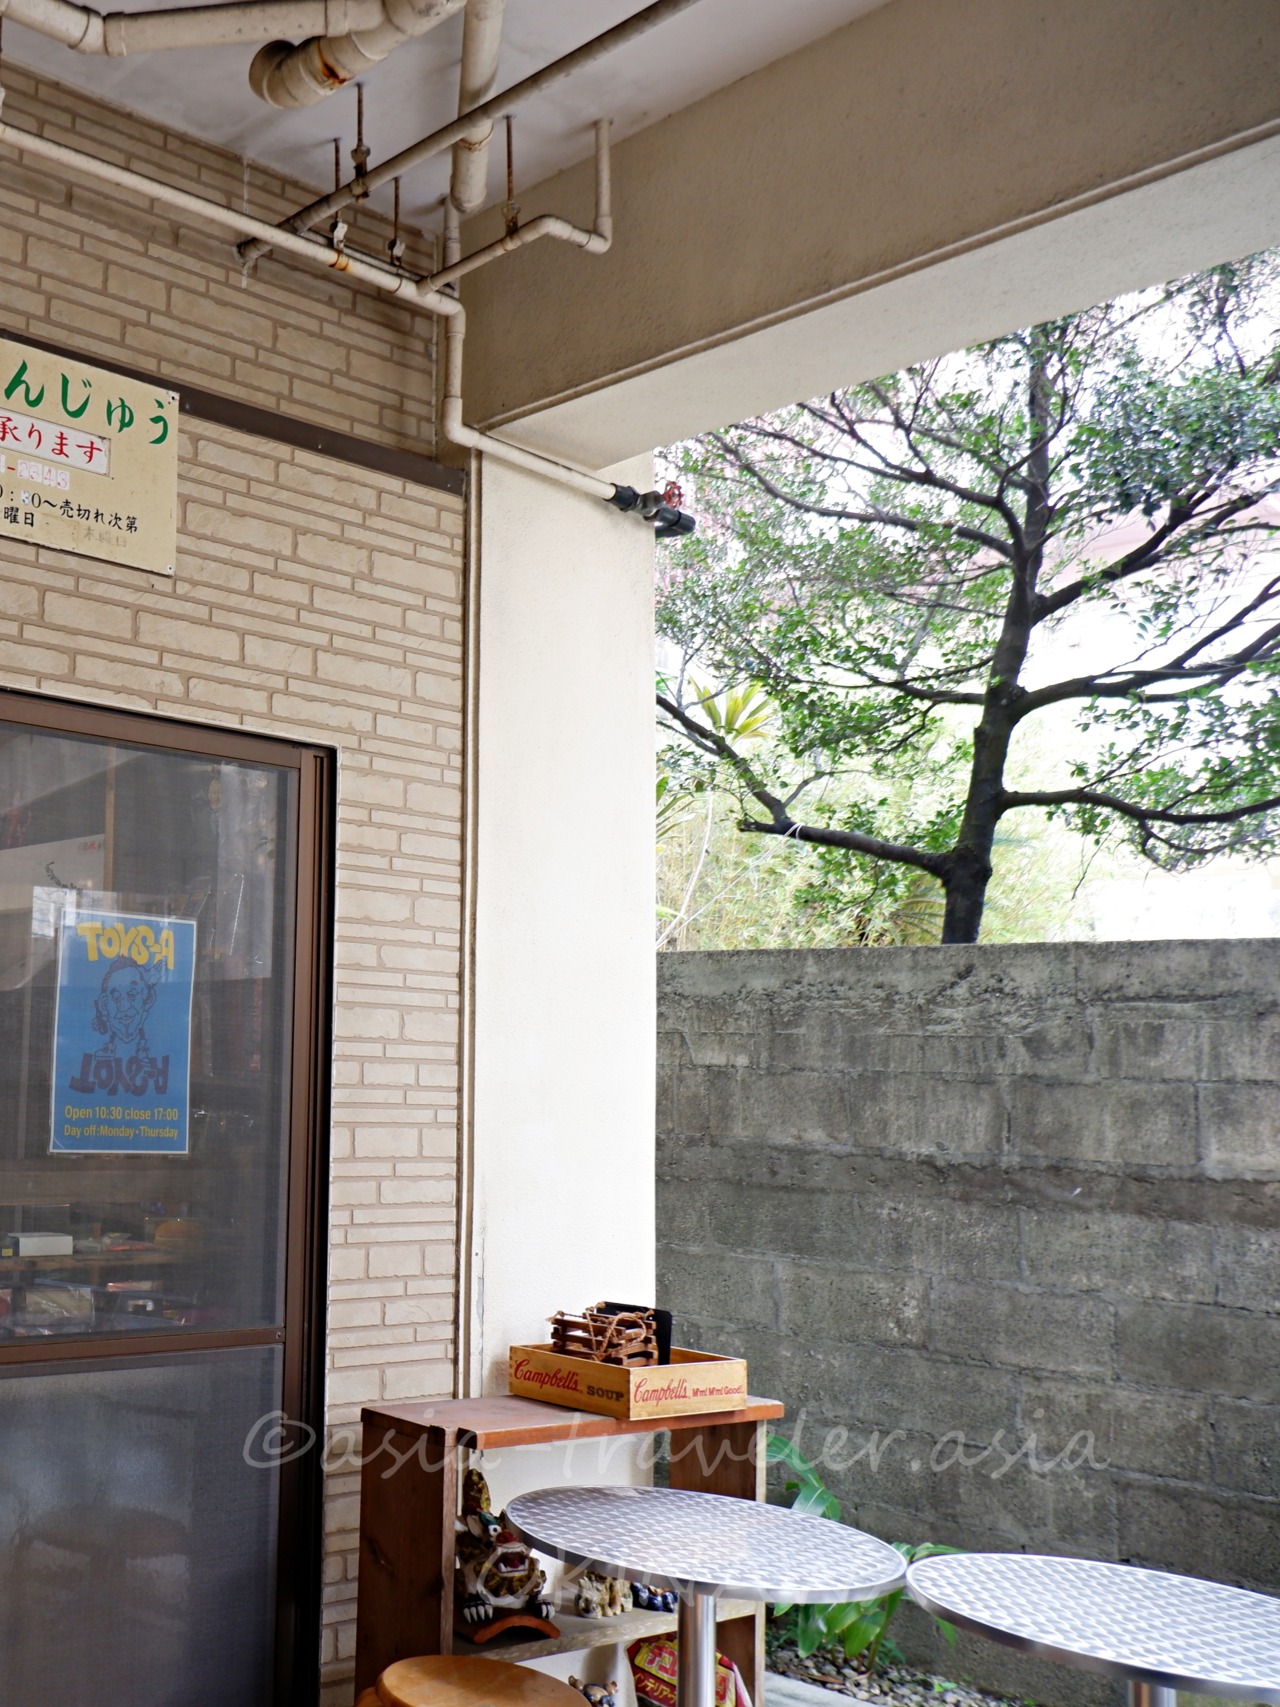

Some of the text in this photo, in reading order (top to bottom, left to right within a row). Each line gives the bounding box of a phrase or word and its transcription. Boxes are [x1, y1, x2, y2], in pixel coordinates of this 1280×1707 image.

[65, 1105, 179, 1122] Open 10:30 close 17:00
[64, 1125, 81, 1138] Day
[514, 1359, 625, 1402] Campbell's SOUP
